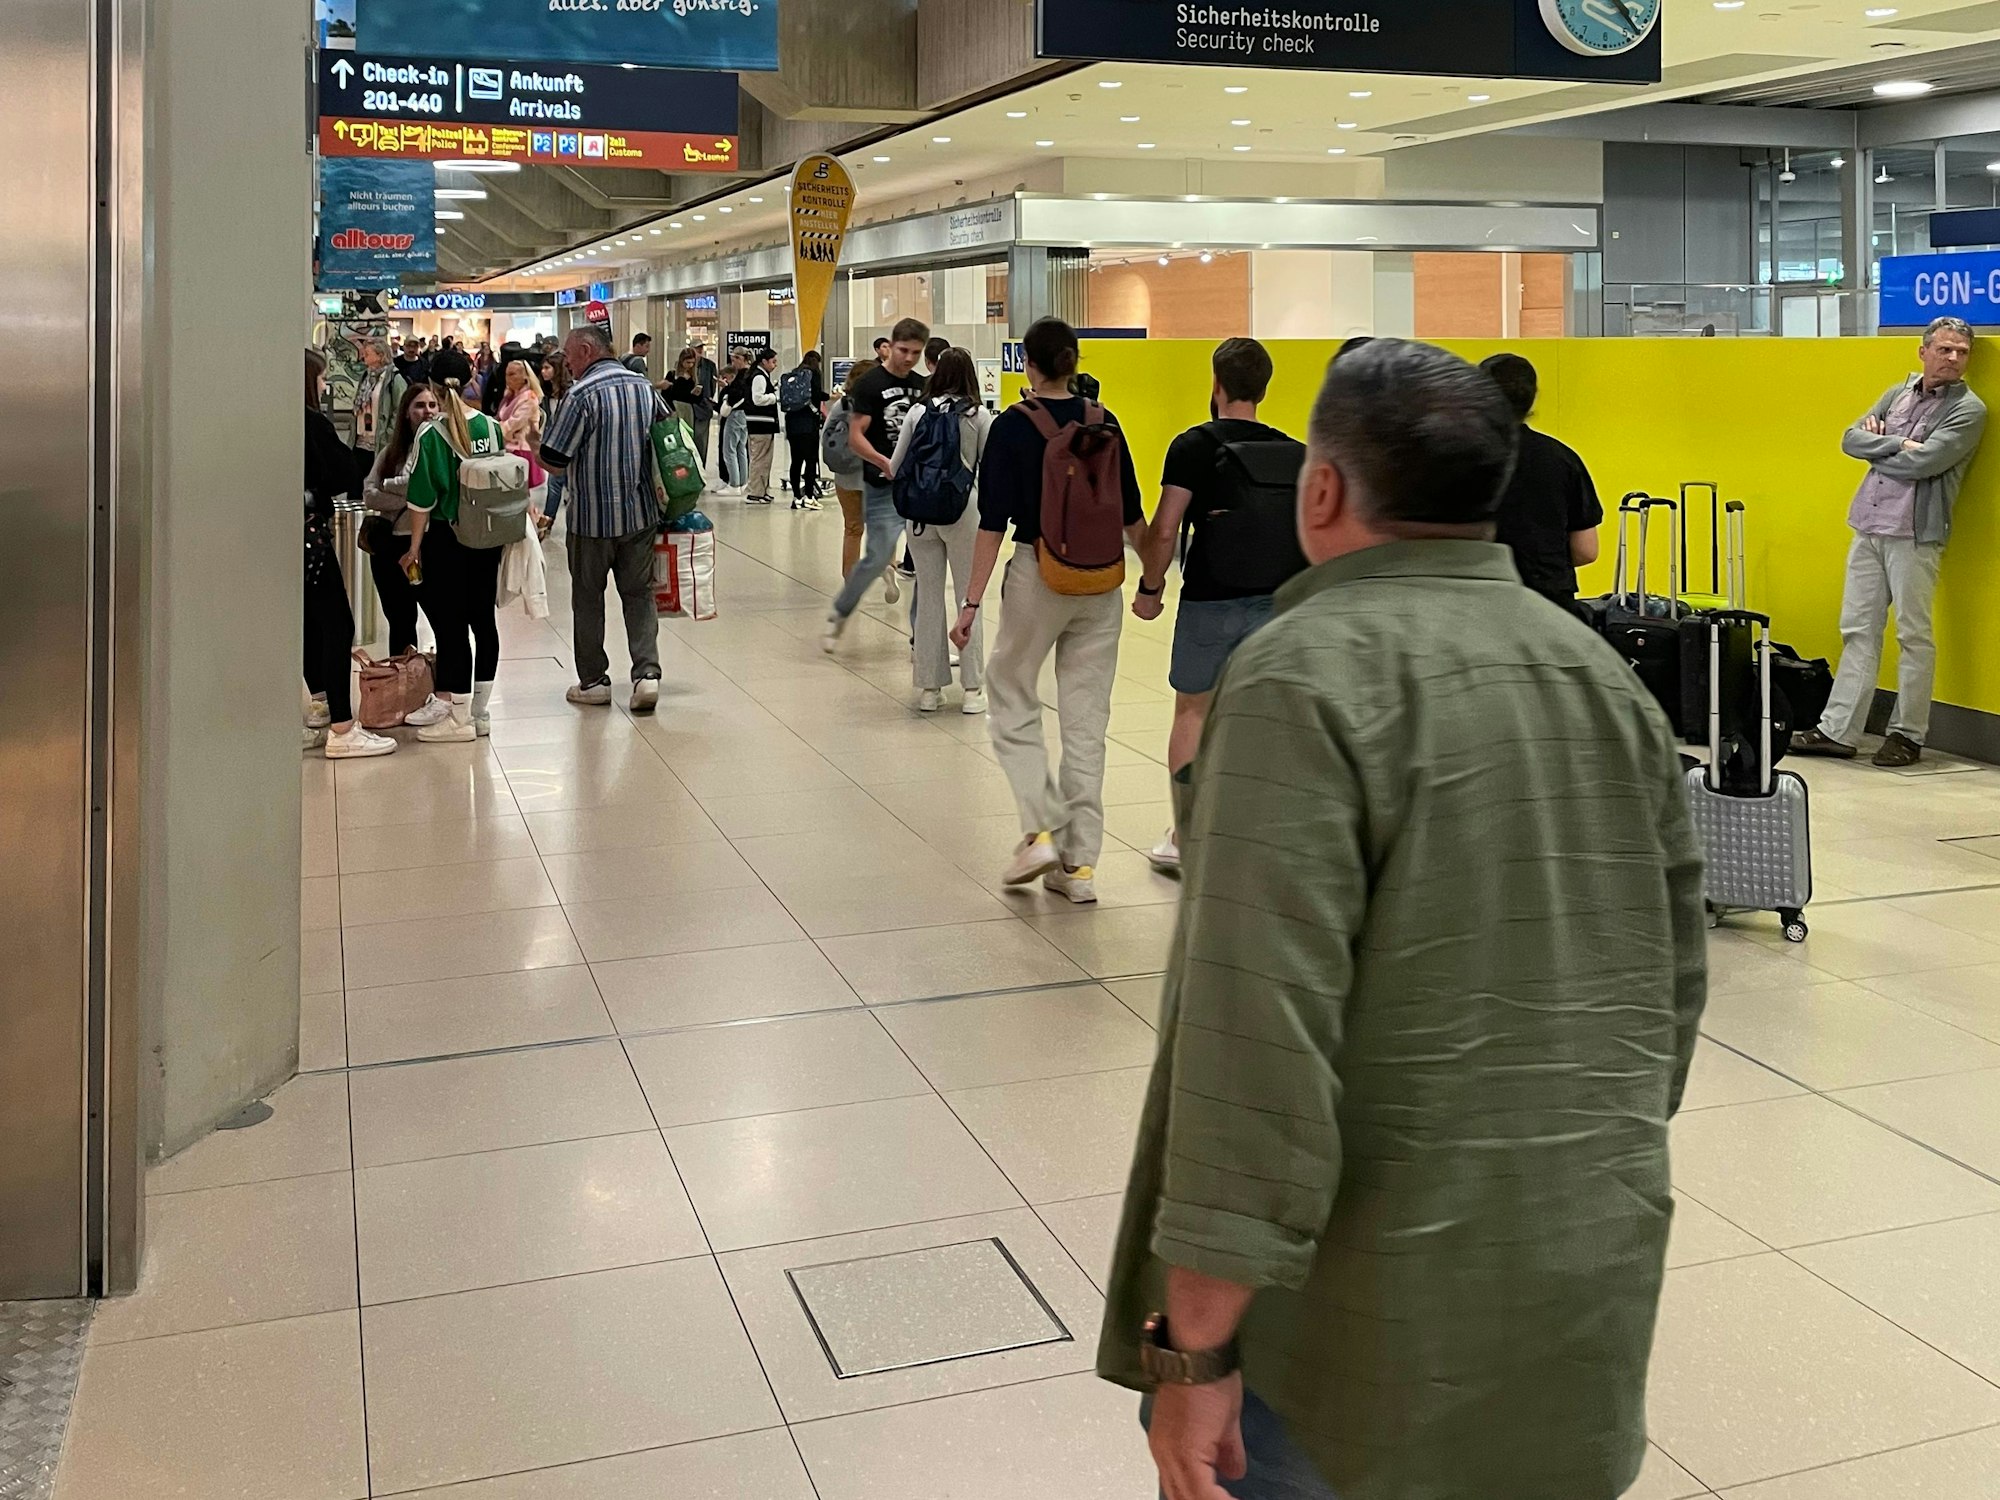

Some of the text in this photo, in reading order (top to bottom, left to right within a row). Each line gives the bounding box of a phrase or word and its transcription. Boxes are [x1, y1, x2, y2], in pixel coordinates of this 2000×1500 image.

[1176, 3, 1380, 33] Sicherheitskontrolle
[1176, 28, 1315, 54] Security check
[362, 61, 449, 86] Check-in
[509, 70, 585, 94] Ankunft
[362, 90, 443, 114] 201-440
[508, 98, 582, 120] Arrivals
[431, 139, 458, 150] Police
[609, 148, 643, 158] Customs
[797, 181, 850, 196] SICHERHEITS
[349, 191, 413, 201] Nicht träumen
[802, 195, 846, 208] KONTROLLE
[347, 201, 415, 211] alltours buchen
[800, 218, 839, 230] ANSTELLEN
[331, 228, 415, 250] alltours
[589, 309, 606, 319] ATM
[728, 333, 767, 345] Eingang
